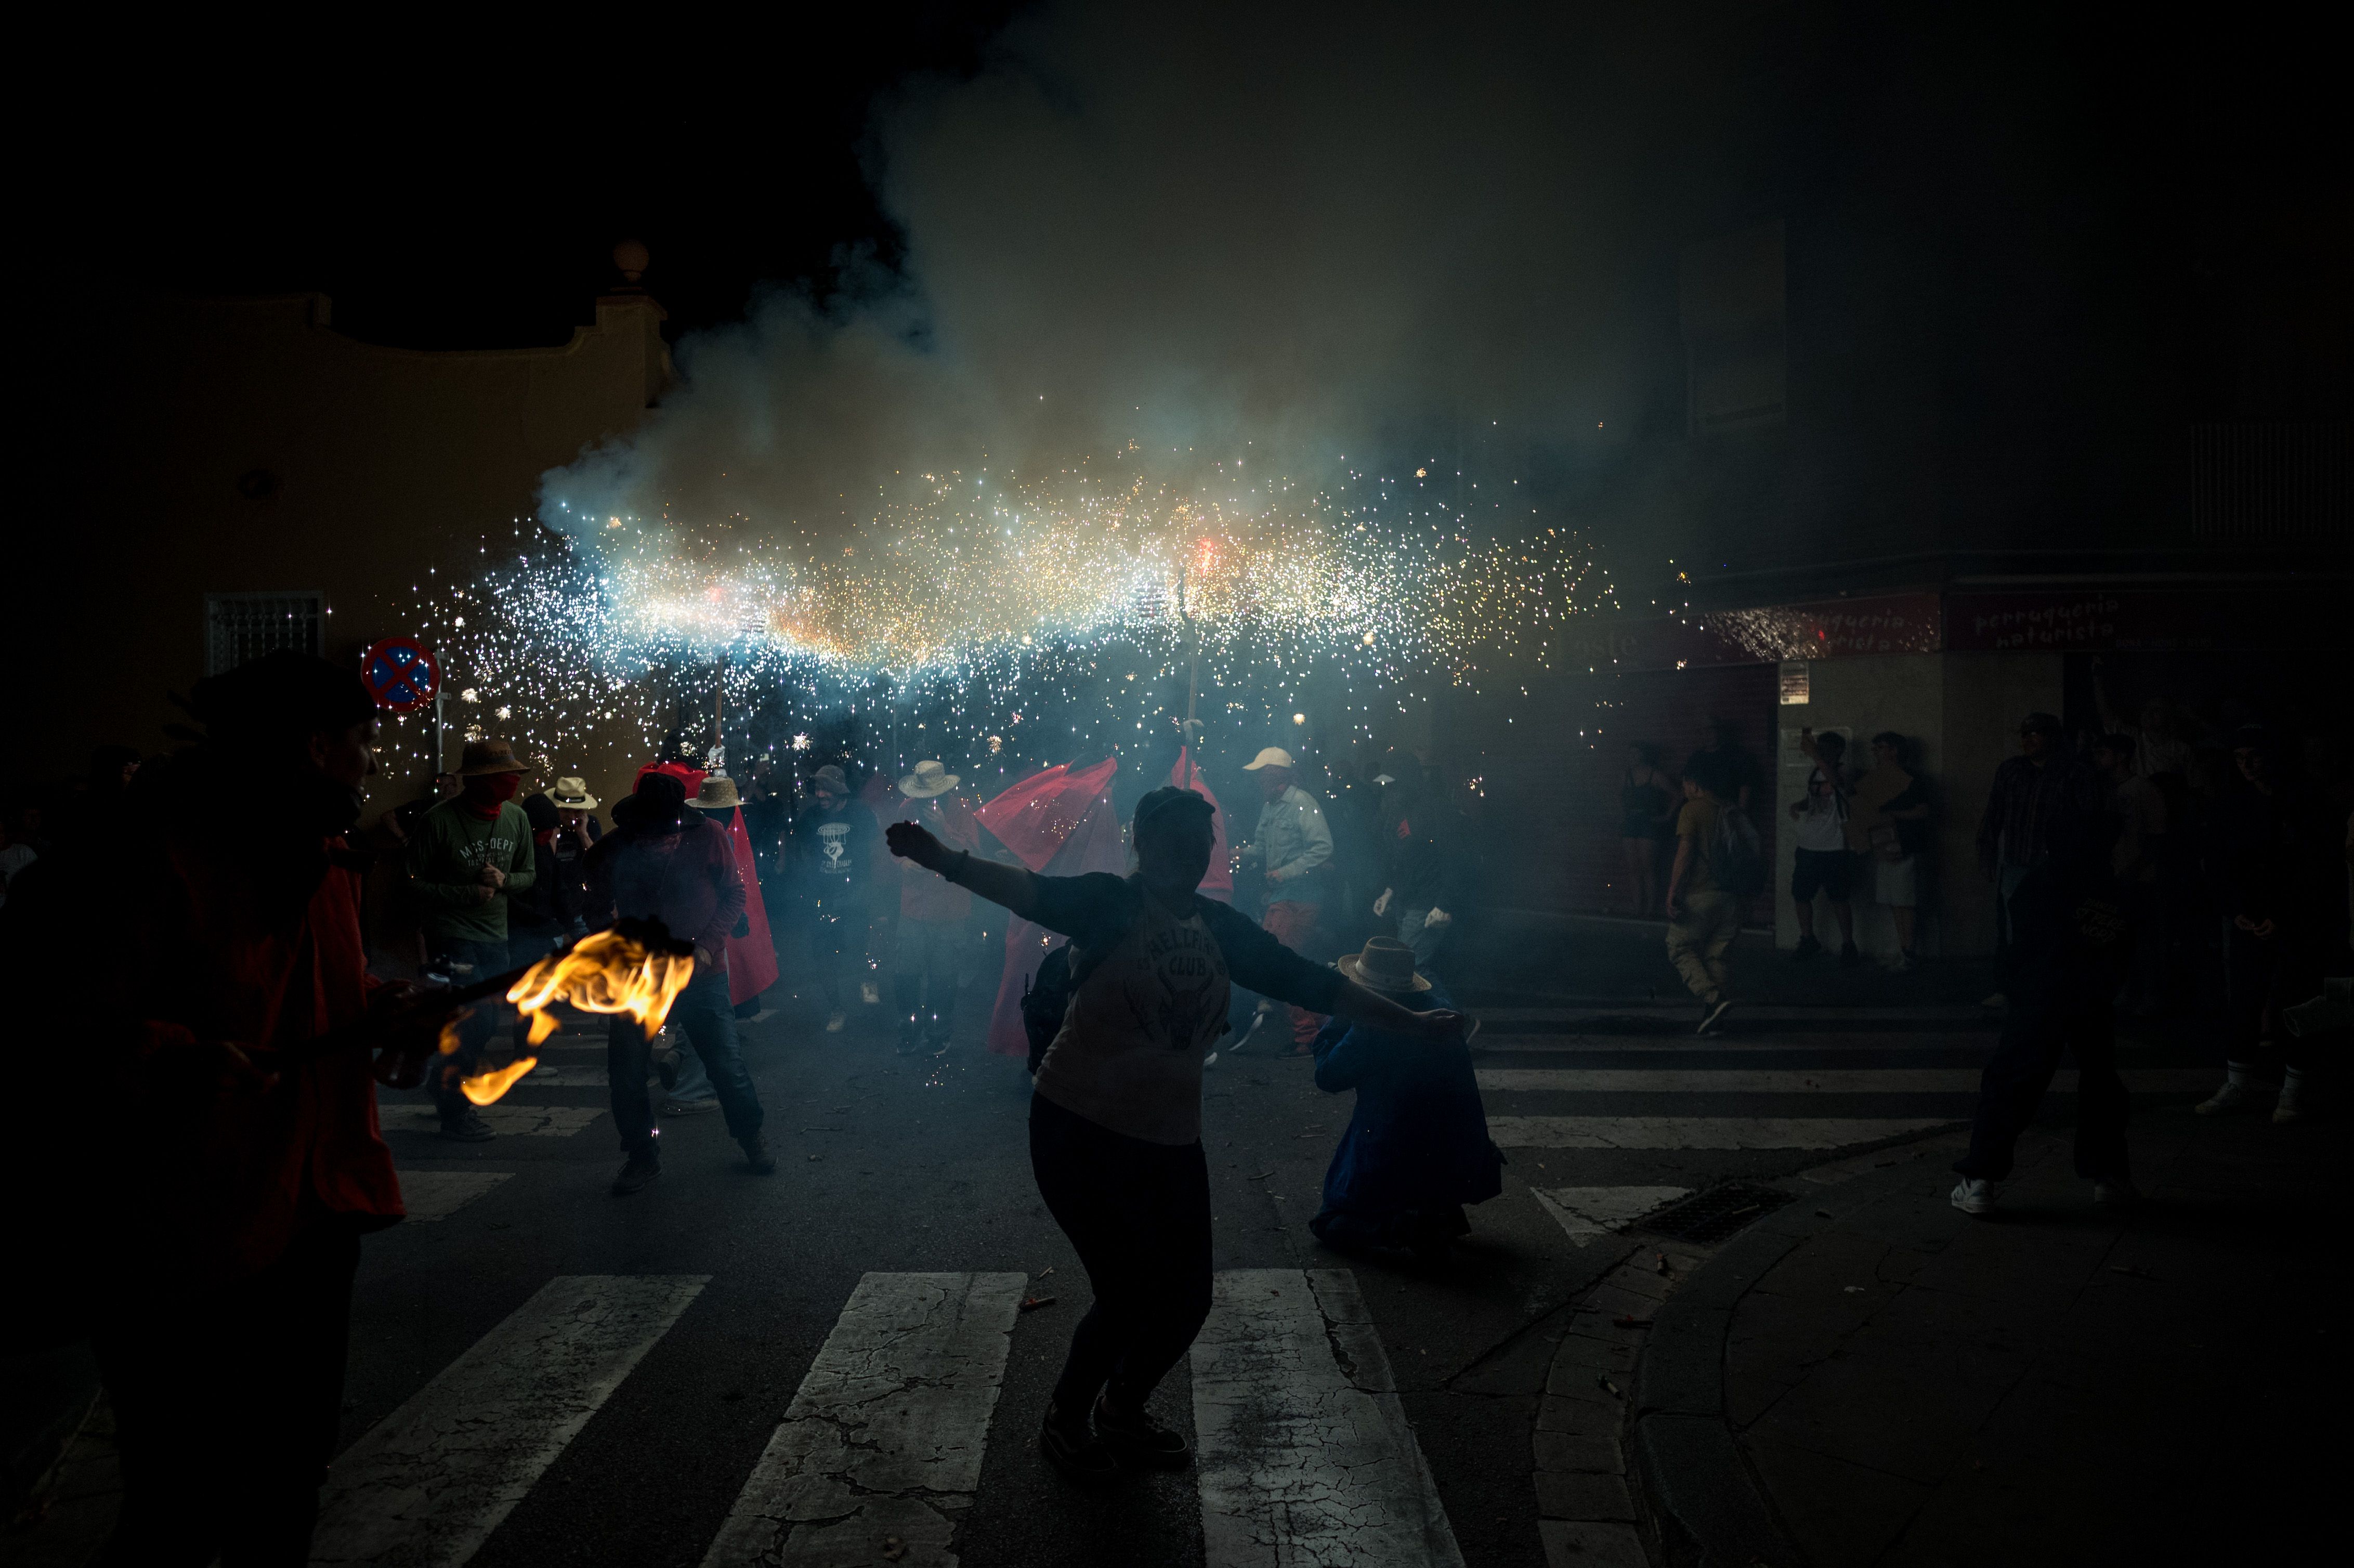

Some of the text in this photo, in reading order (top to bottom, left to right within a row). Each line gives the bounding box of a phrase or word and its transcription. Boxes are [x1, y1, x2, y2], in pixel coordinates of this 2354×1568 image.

[1973, 593, 2120, 636] perruqueria
[1995, 620, 2114, 648] naturista
[2090, 911, 2126, 931] PERE
[1169, 955, 1207, 976] CLUB
